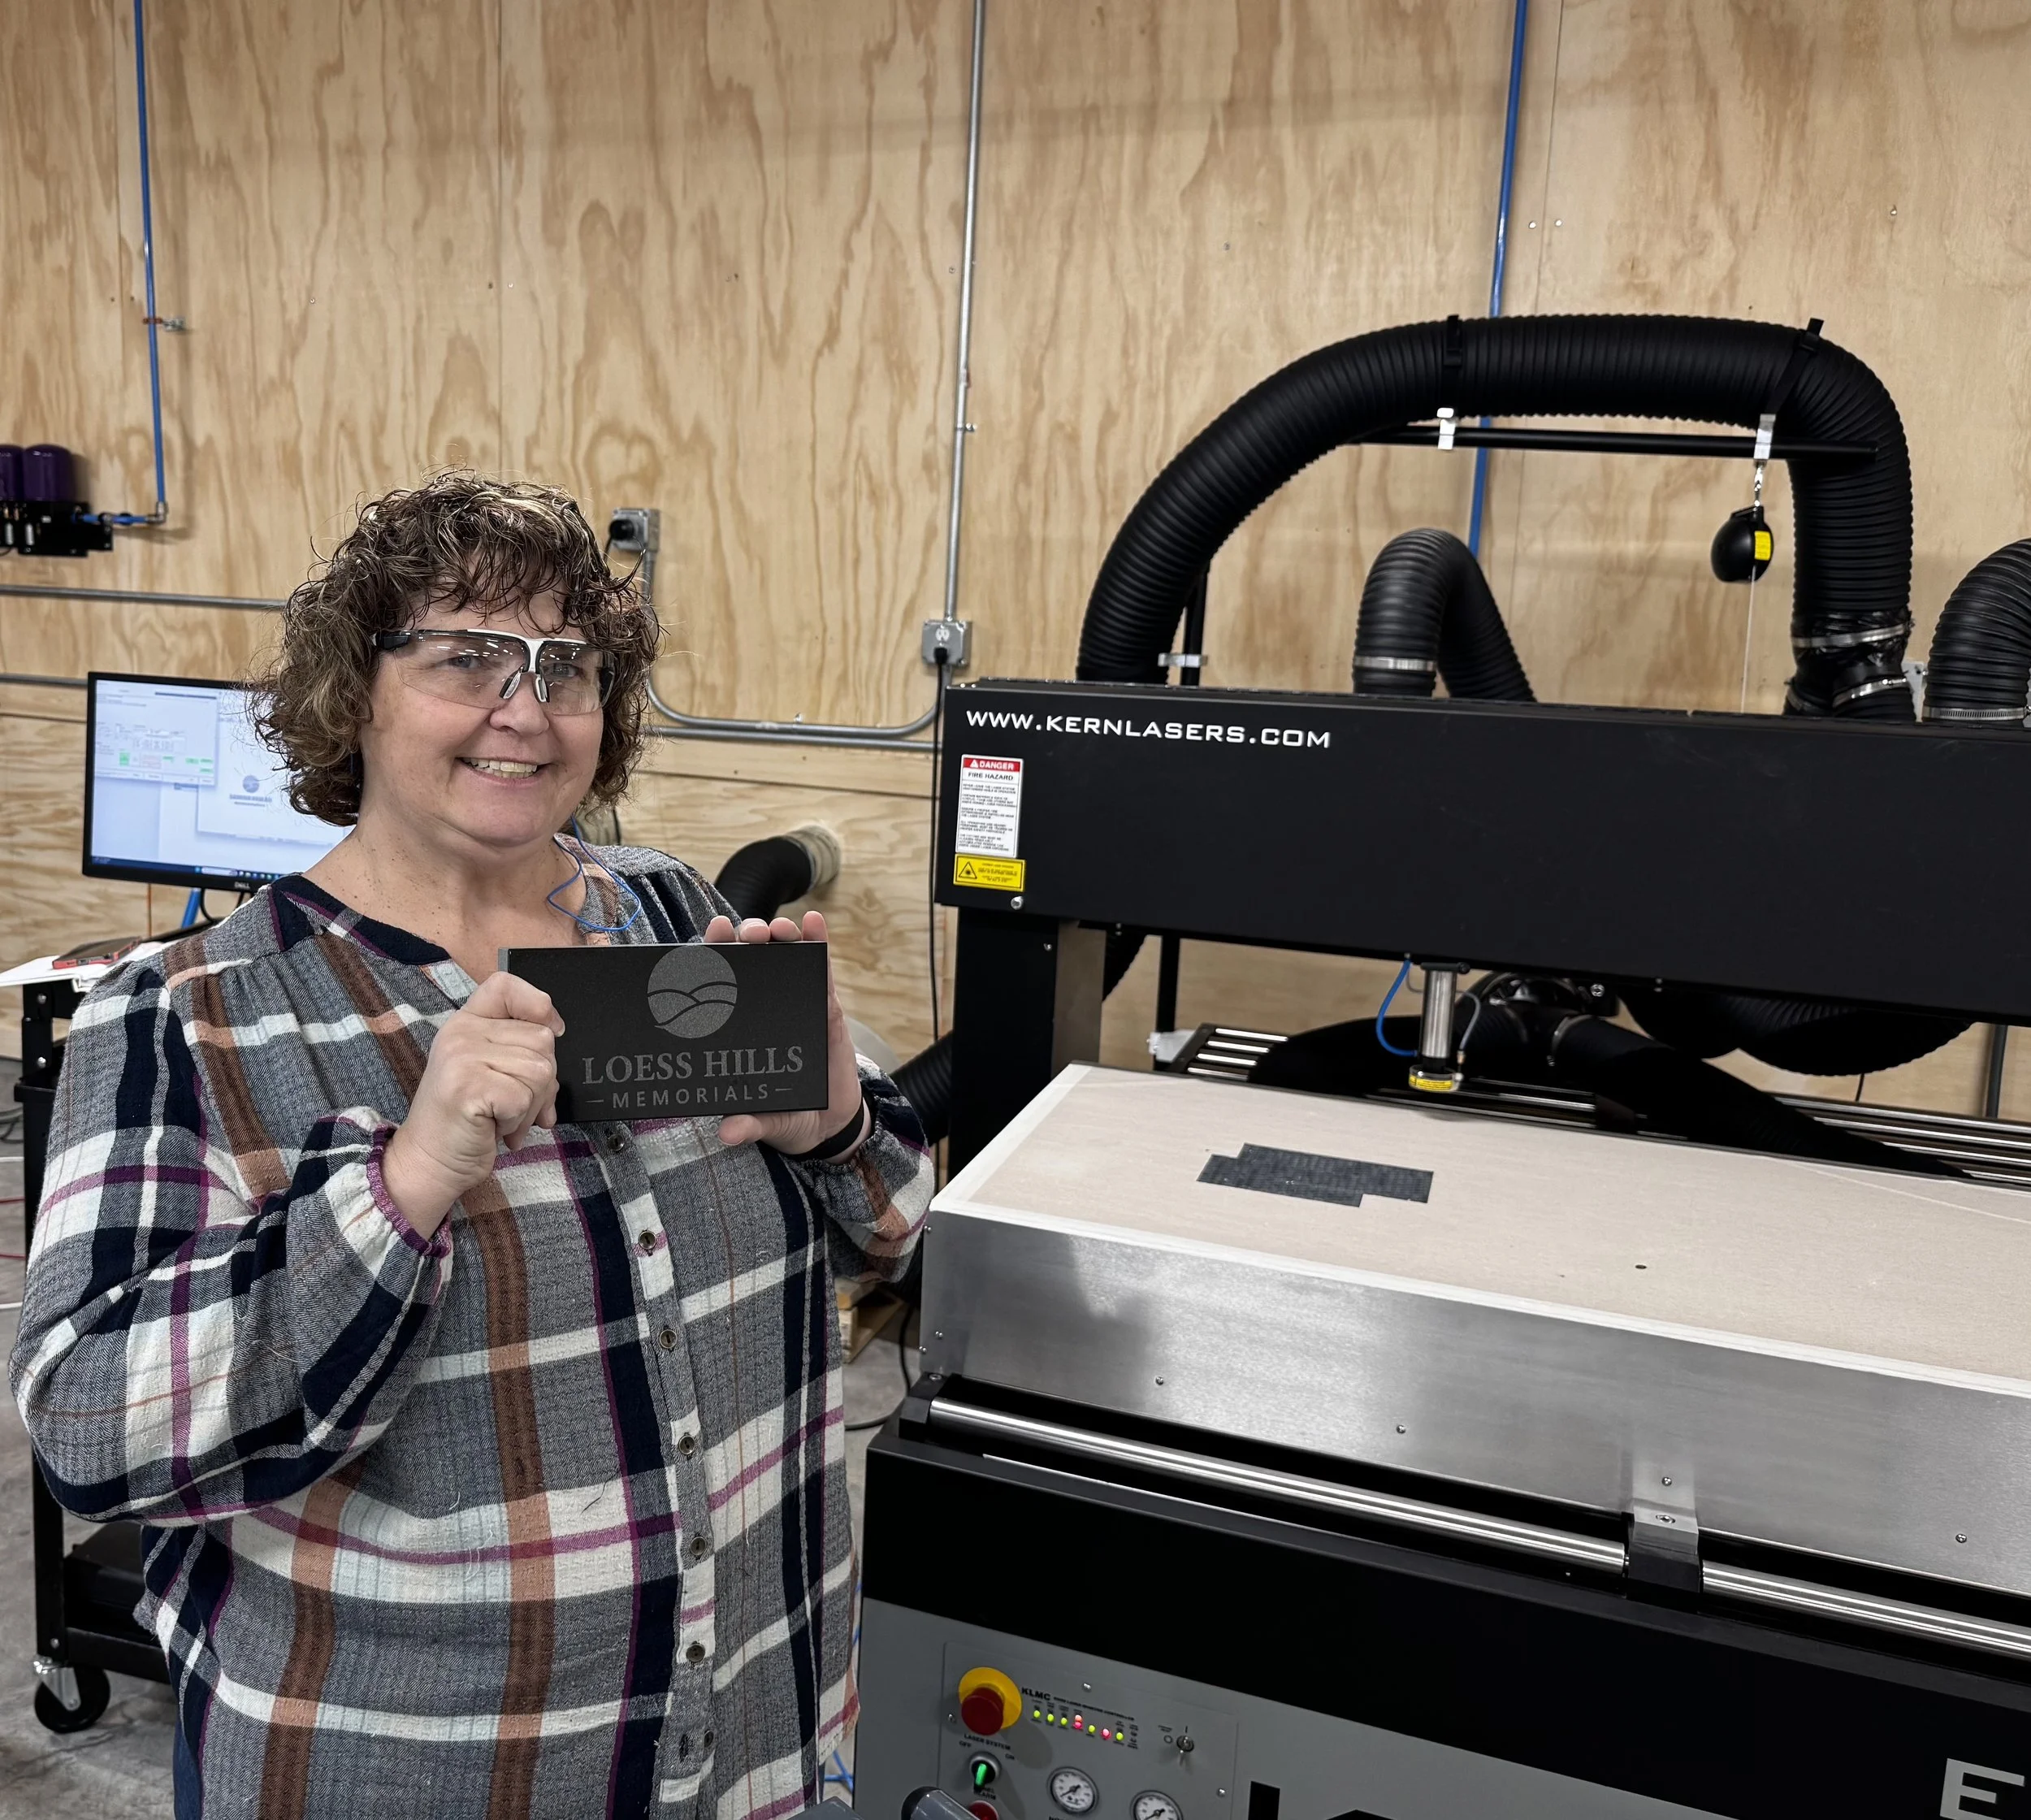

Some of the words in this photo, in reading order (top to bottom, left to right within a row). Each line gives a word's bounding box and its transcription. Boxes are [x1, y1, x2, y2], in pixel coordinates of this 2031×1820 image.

[966, 710, 1332, 748] WWW.KERNLASERS.COM
[979, 760, 1015, 770] DANGER
[582, 1051, 693, 1085] LOESS
[704, 1046, 803, 1078] HILLS
[612, 1083, 769, 1109] MEMORIALS
[1021, 1687, 1050, 1701] KLMC
